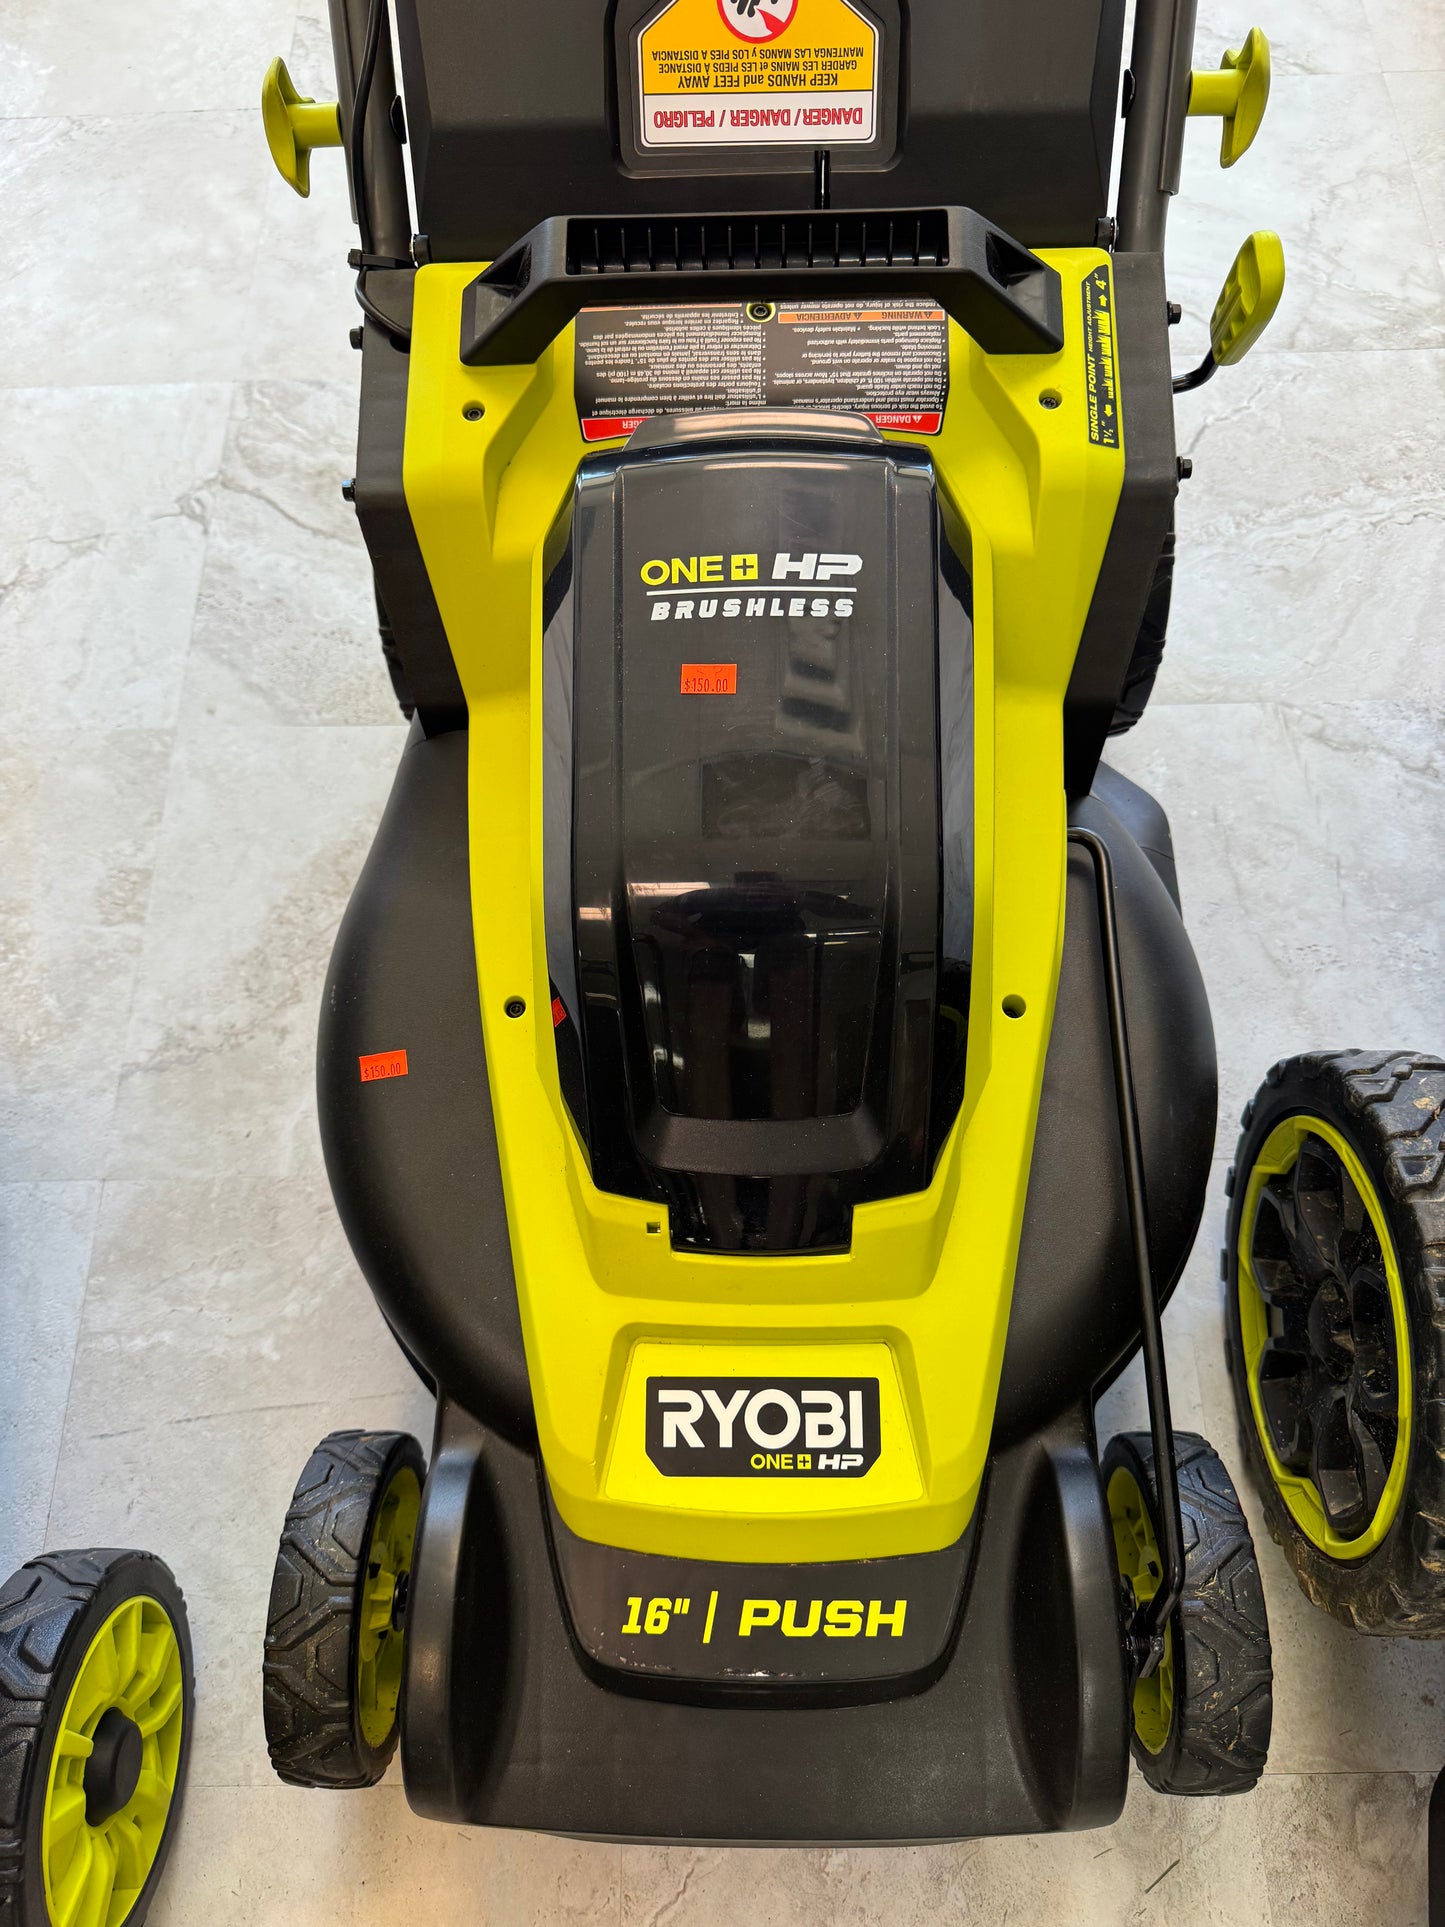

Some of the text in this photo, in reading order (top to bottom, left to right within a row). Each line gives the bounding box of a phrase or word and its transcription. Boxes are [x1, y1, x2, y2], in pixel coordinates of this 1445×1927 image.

[652, 47, 863, 60] MANTENGA LAS MANOS y LOS PIES A DISTANCIA
[659, 63, 701, 74] DISTANCE
[713, 62, 738, 73] PIEDS
[741, 62, 757, 72] LES
[760, 61, 768, 72] et
[771, 61, 800, 71] MAINS
[803, 61, 819, 71] LES
[822, 60, 857, 71] GARDER
[678, 74, 838, 88] KEEP HANDS and FEET AWAY
[654, 111, 714, 128] PELIGRO
[730, 109, 790, 127] DANGER
[796, 312, 851, 321] ADVERTENCIA
[1087, 354, 1096, 398] POINT
[875, 415, 911, 423] DANGER
[1089, 399, 1100, 441] SINGLE
[772, 553, 863, 580] HP
[651, 598, 854, 621] BRUSHLESS
[684, 677, 728, 692] $150.00
[364, 1063, 401, 1078] $150.00
[658, 1389, 863, 1449] RYOBI
[817, 1454, 864, 1470] HP
[621, 1597, 907, 1637] 16" PUSH
